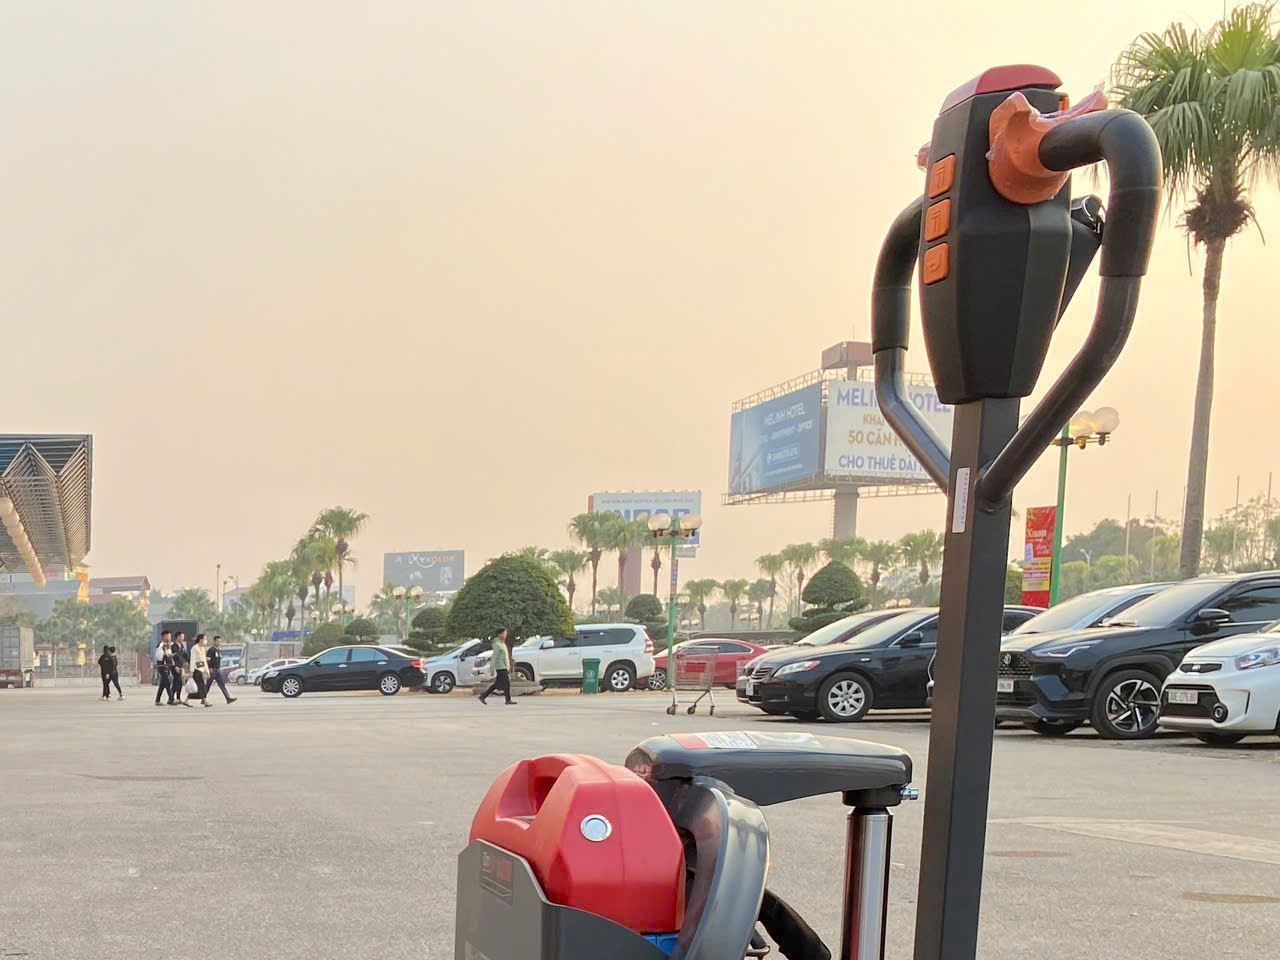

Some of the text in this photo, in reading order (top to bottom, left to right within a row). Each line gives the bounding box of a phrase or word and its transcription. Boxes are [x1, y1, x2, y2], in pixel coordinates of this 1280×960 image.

[836, 387, 952, 413] MELI OTEL
[848, 430, 864, 445] 50
[838, 455, 865, 469] CHO
